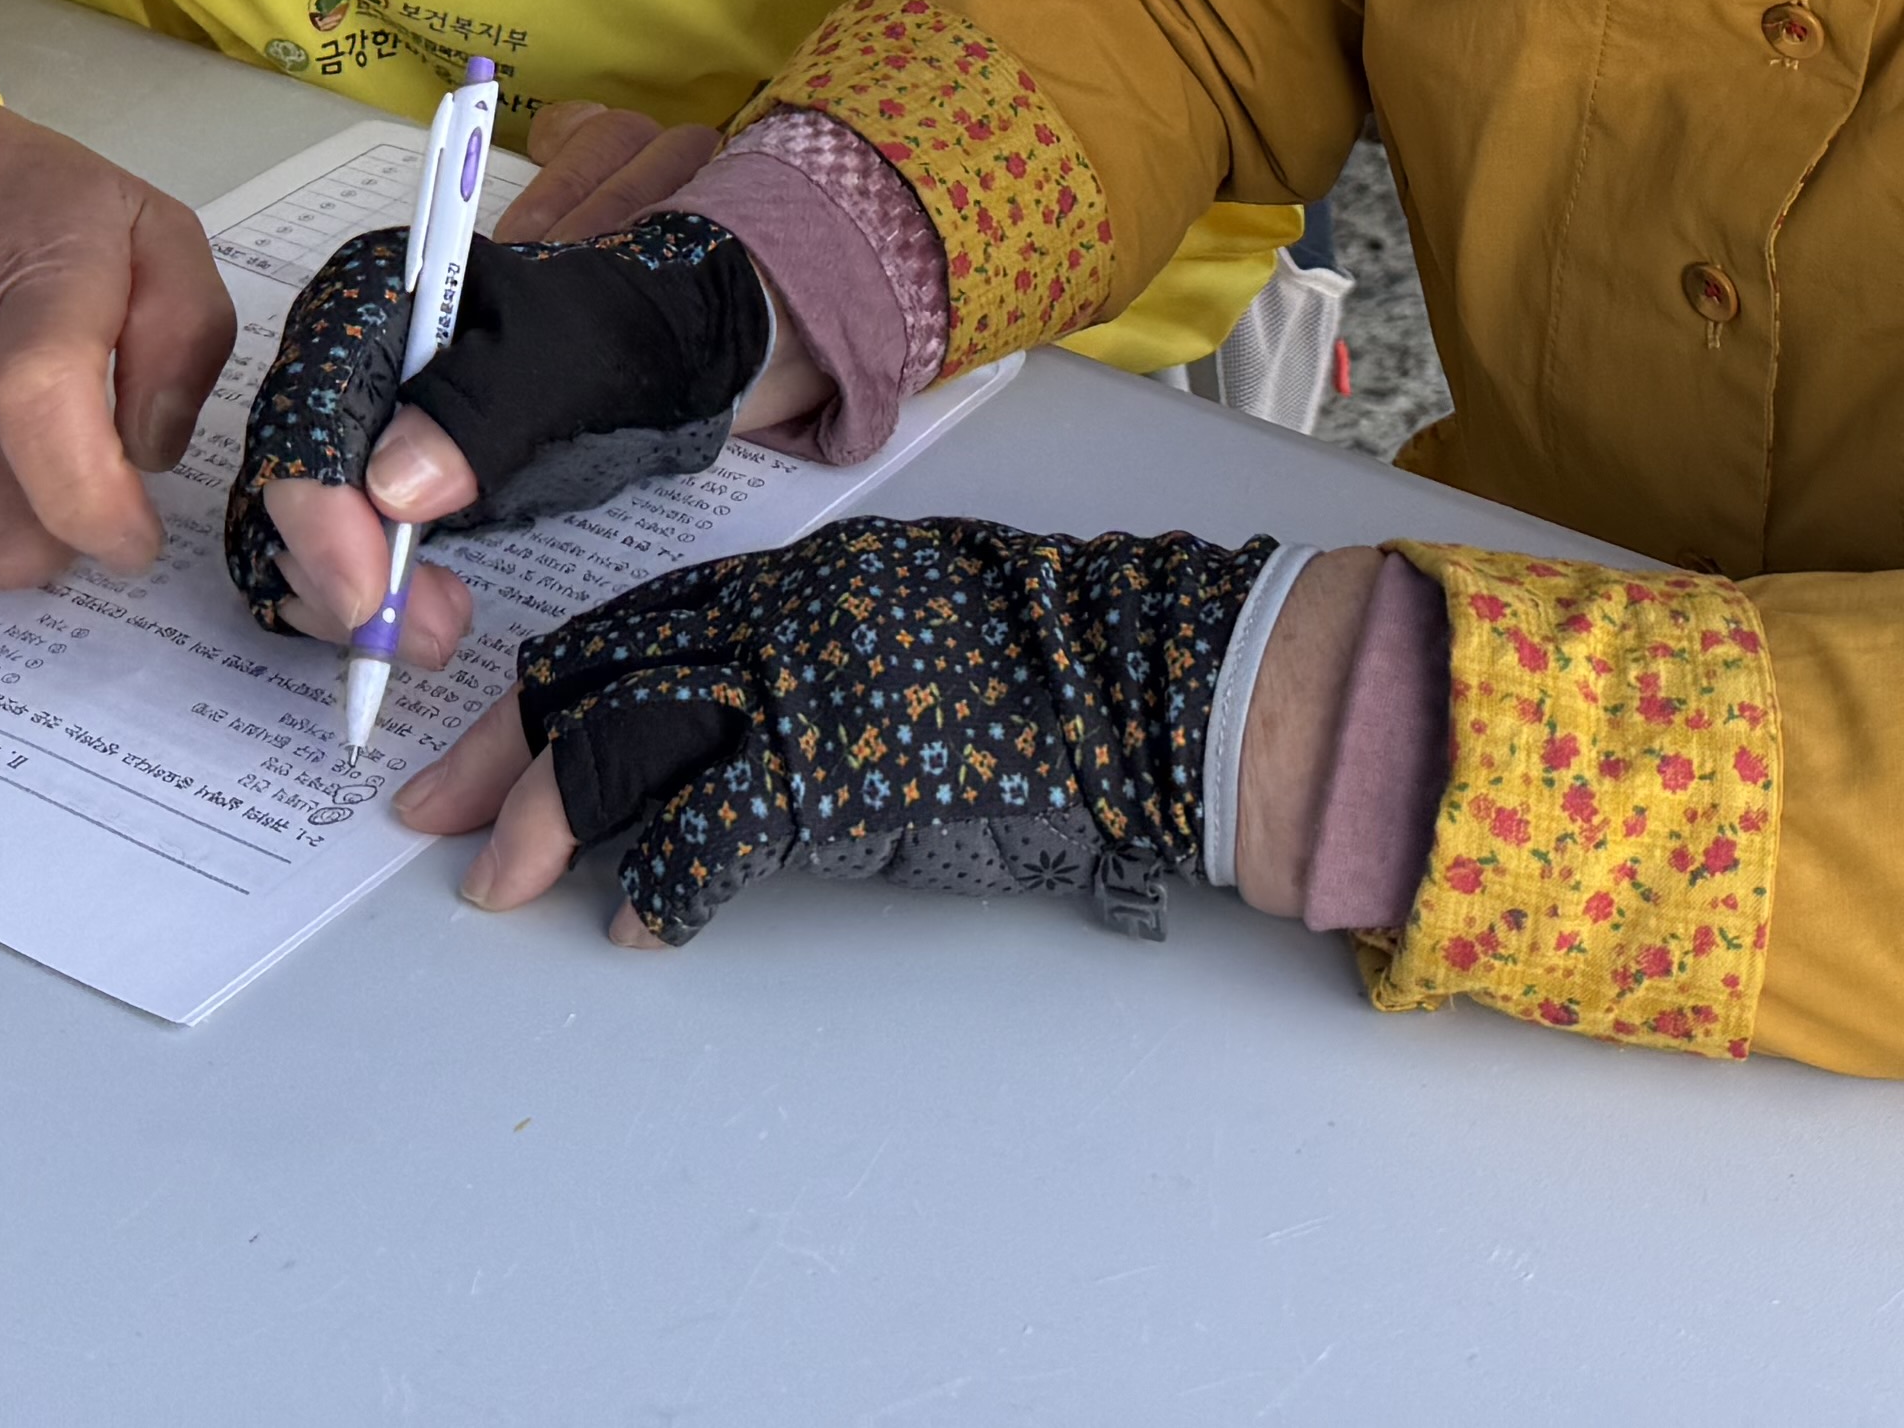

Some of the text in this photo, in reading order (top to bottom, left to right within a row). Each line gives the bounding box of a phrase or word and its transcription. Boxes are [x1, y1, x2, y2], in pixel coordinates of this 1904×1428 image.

[398, 1, 528, 53] 보건복지부
[64, 723, 120, 756] 생각하는
[120, 751, 194, 790] 중요하다고
[236, 772, 271, 793] 건강
